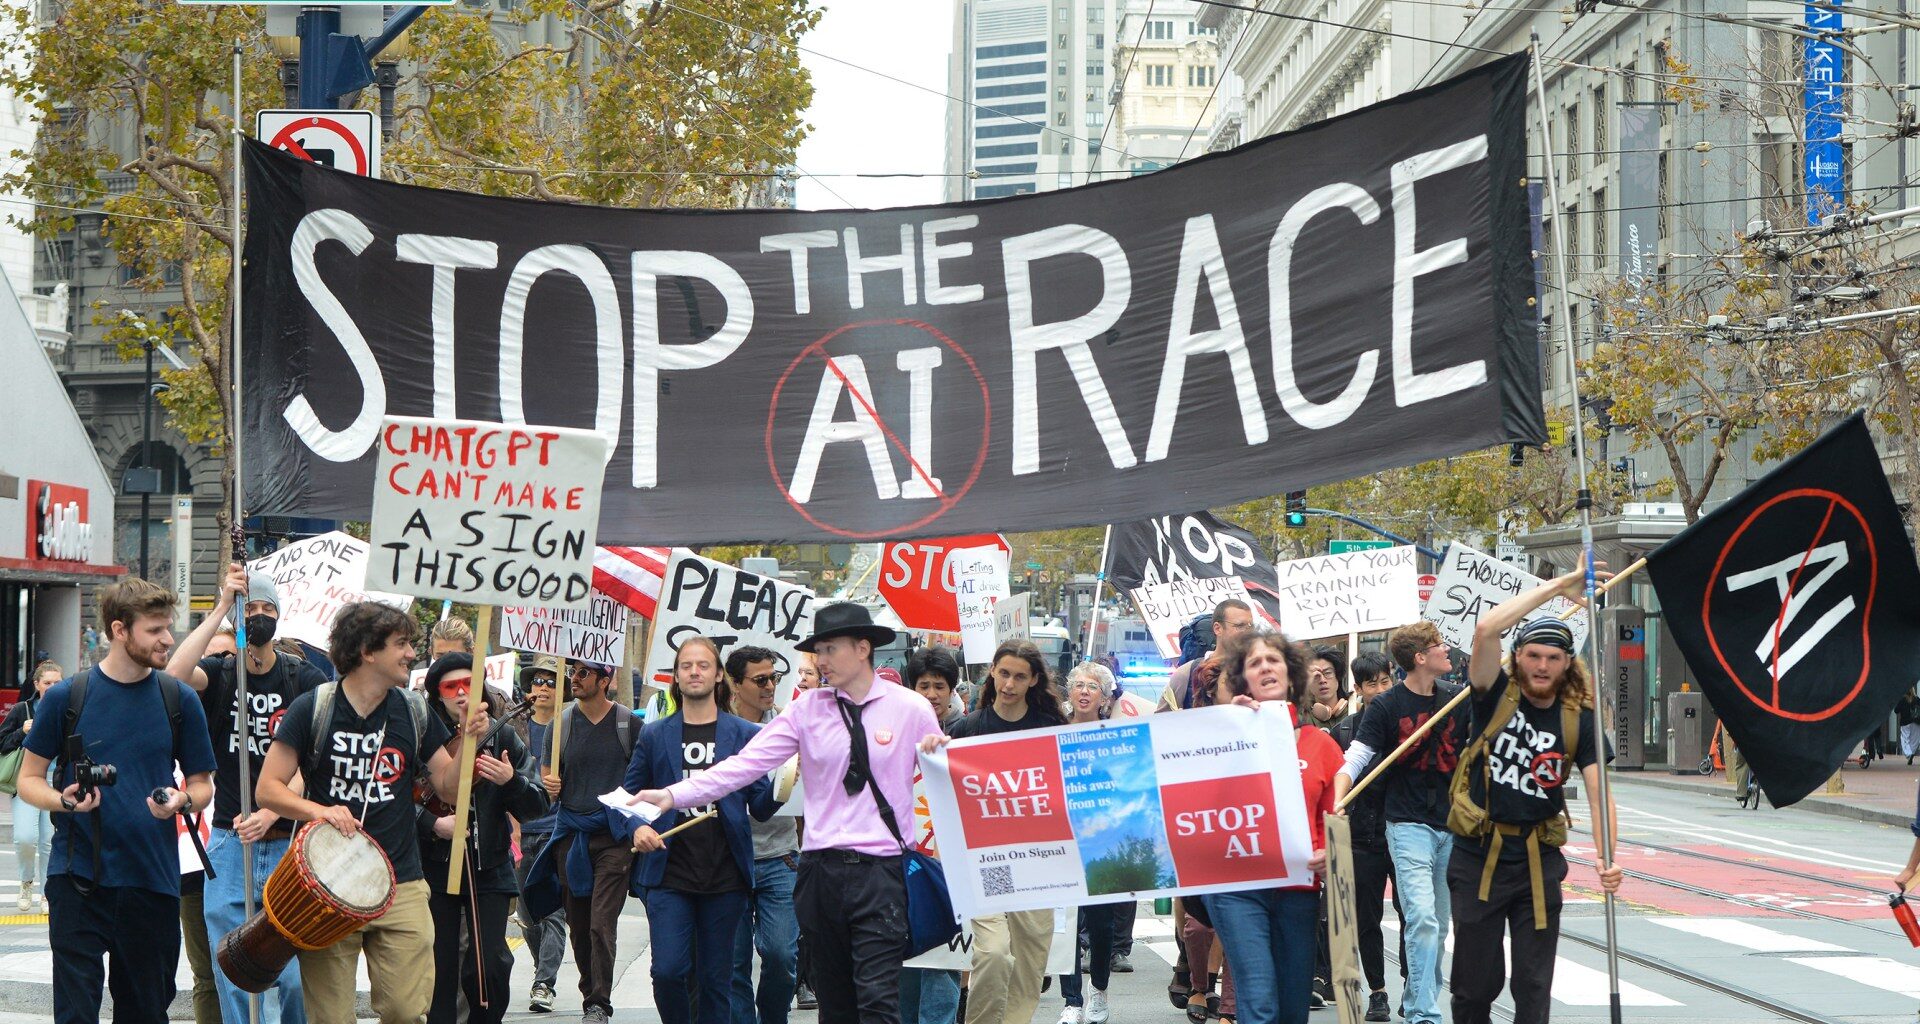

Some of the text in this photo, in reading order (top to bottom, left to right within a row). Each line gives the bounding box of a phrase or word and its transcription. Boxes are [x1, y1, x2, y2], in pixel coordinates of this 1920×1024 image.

[283, 134, 1488, 490] STOP THE RACE
[788, 346, 943, 504] AI
[384, 424, 560, 469] CHATGPT
[389, 462, 585, 511] CAN'T MAKE
[402, 508, 585, 561] A SIGN
[1346, 544, 1361, 552] 5th
[272, 546, 303, 575] NO
[308, 539, 363, 563] ONE
[885, 543, 960, 594] STO
[1287, 548, 1414, 577] MAY YOUR
[178, 563, 187, 593] Powell
[315, 561, 342, 582] IT
[1456, 552, 1523, 597] ENOUGH
[1134, 576, 1241, 603] IF ANYONE
[1281, 572, 1393, 599] TRAINING
[667, 558, 814, 642] PLEASE
[1145, 594, 1218, 621] BUILDS
[1295, 594, 1367, 612] RUNS
[1726, 540, 1857, 682] AI
[1014, 606, 1023, 629] AI
[1308, 608, 1387, 630] FAIL
[508, 616, 619, 664] WON'T WORK
[486, 661, 506, 681] AI
[1619, 666, 1629, 758] POWELL STREET
[229, 734, 272, 756] RAC
[1059, 727, 1139, 746] Billionares are
[1161, 739, 1259, 760] www.stopai.live
[1061, 743, 1137, 764] trying to take
[961, 766, 1049, 797] SAVE
[1064, 764, 1093, 778] all of
[329, 776, 395, 803] RACE
[1066, 782, 1087, 795] this
[977, 793, 1053, 820] LIFE
[1068, 798, 1096, 811] from
[1175, 803, 1266, 837] STOP
[979, 845, 1066, 864] Join On Signal
[1224, 831, 1264, 859] AI
